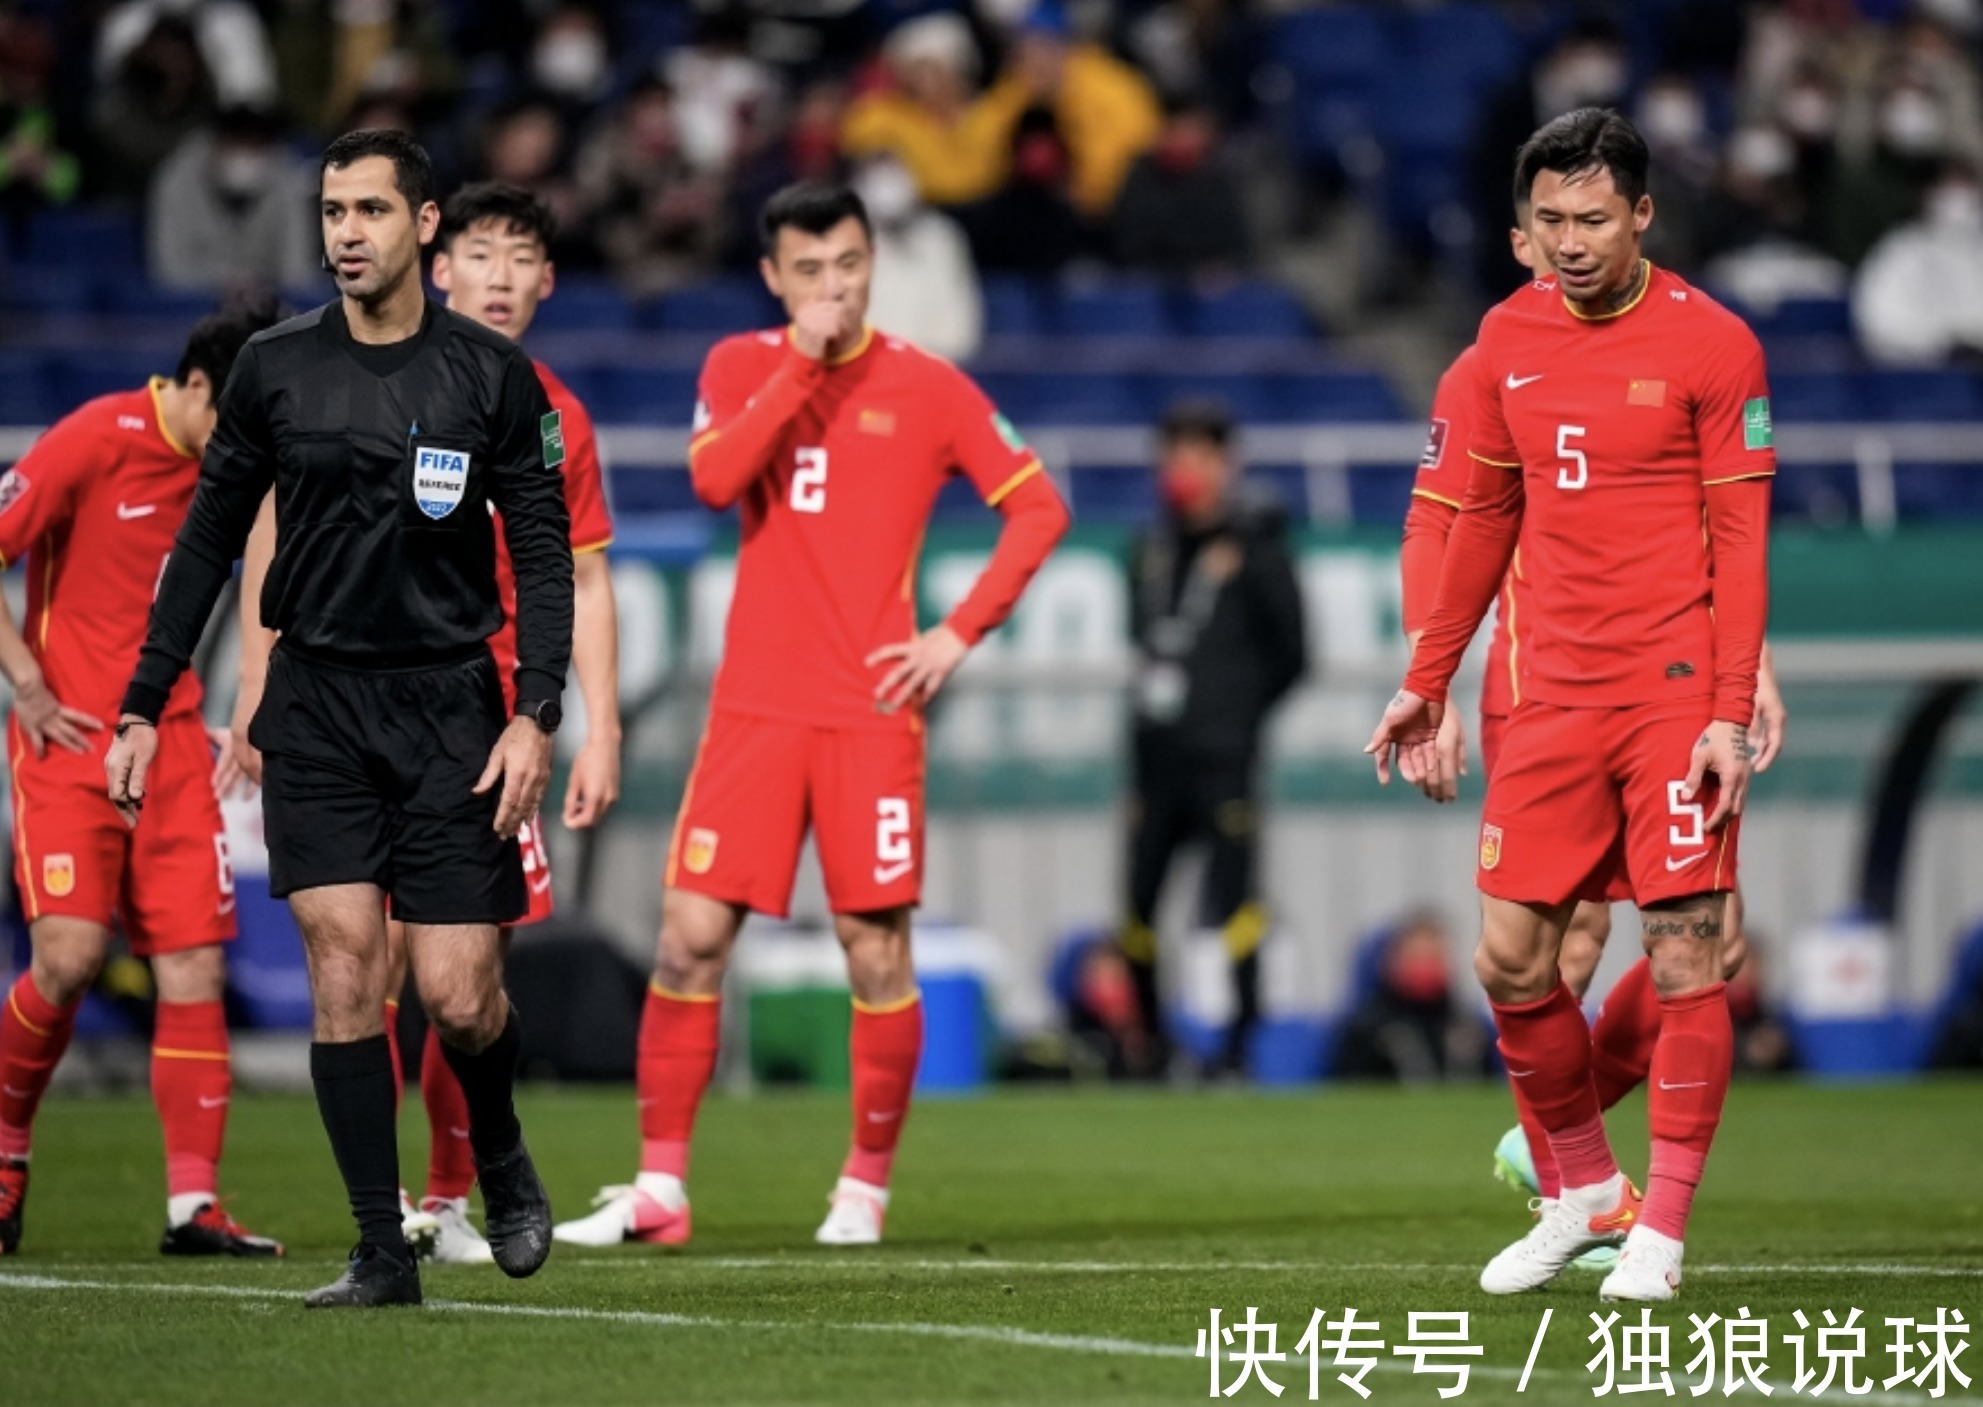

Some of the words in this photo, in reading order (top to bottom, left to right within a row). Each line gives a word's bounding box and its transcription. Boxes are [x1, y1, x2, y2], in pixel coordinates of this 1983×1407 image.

[420, 452, 464, 473] FIFA
[790, 446, 828, 513] 2
[1556, 424, 1588, 490] 5
[875, 798, 911, 861] 2
[1667, 780, 1705, 846] 5
